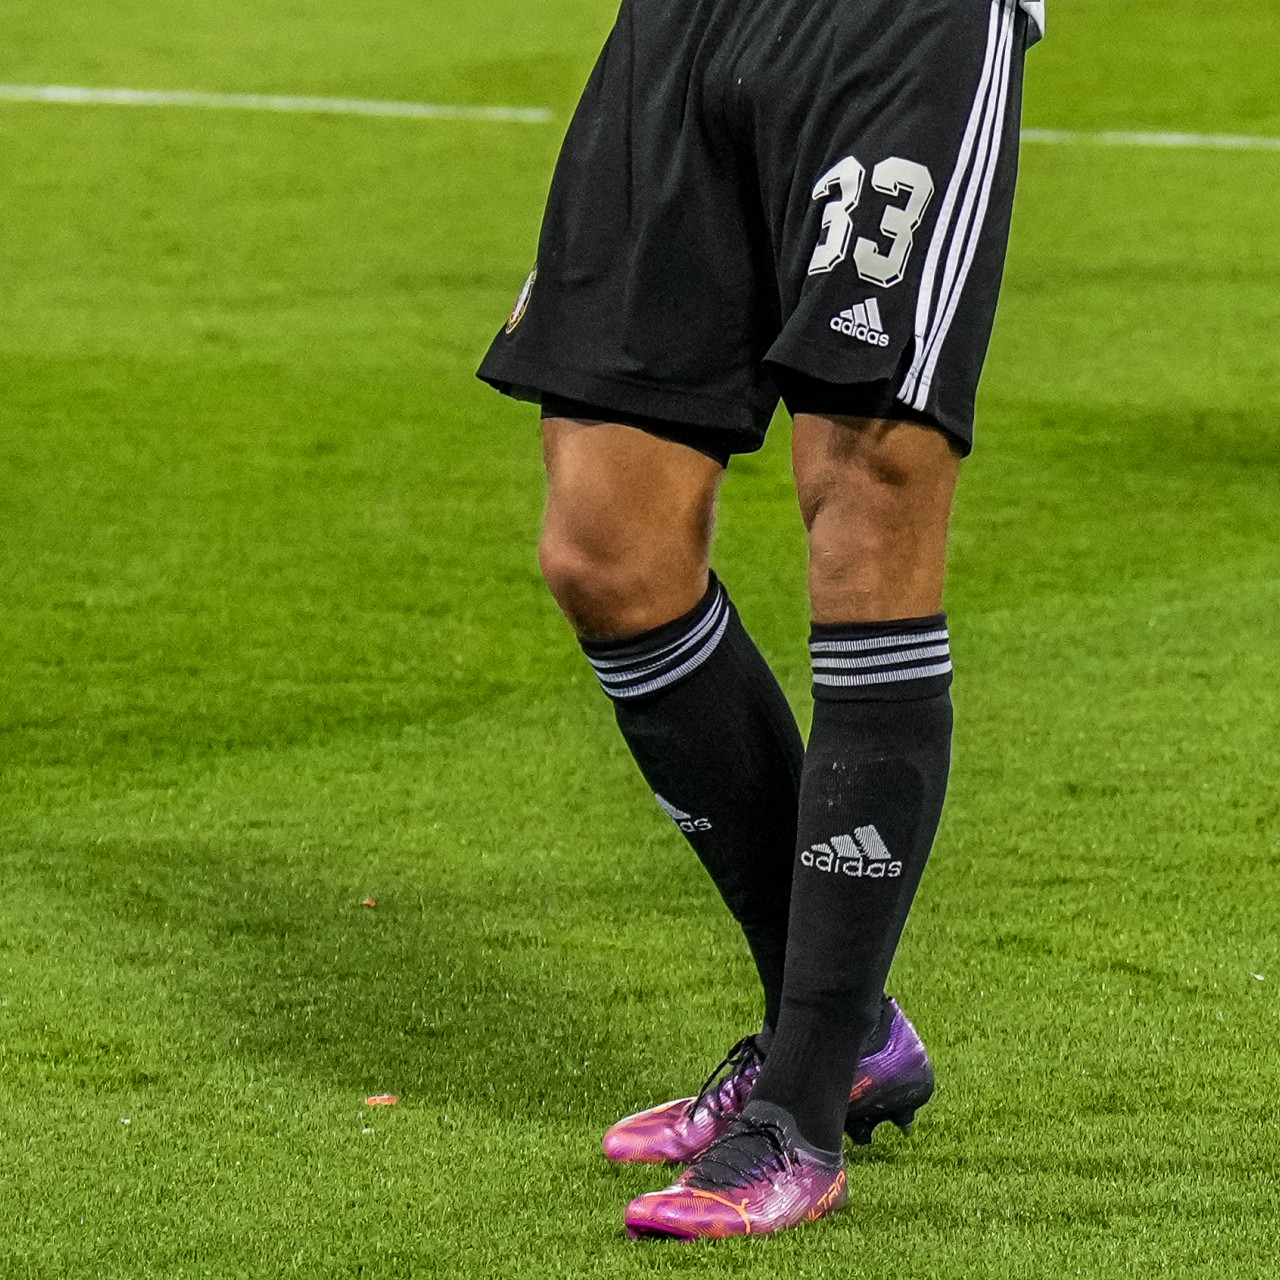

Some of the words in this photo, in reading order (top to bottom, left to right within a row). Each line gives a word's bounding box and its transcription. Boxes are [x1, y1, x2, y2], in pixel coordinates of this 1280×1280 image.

[808, 155, 935, 289] 33
[830, 316, 890, 348] adidas
[800, 848, 903, 879] adidas
